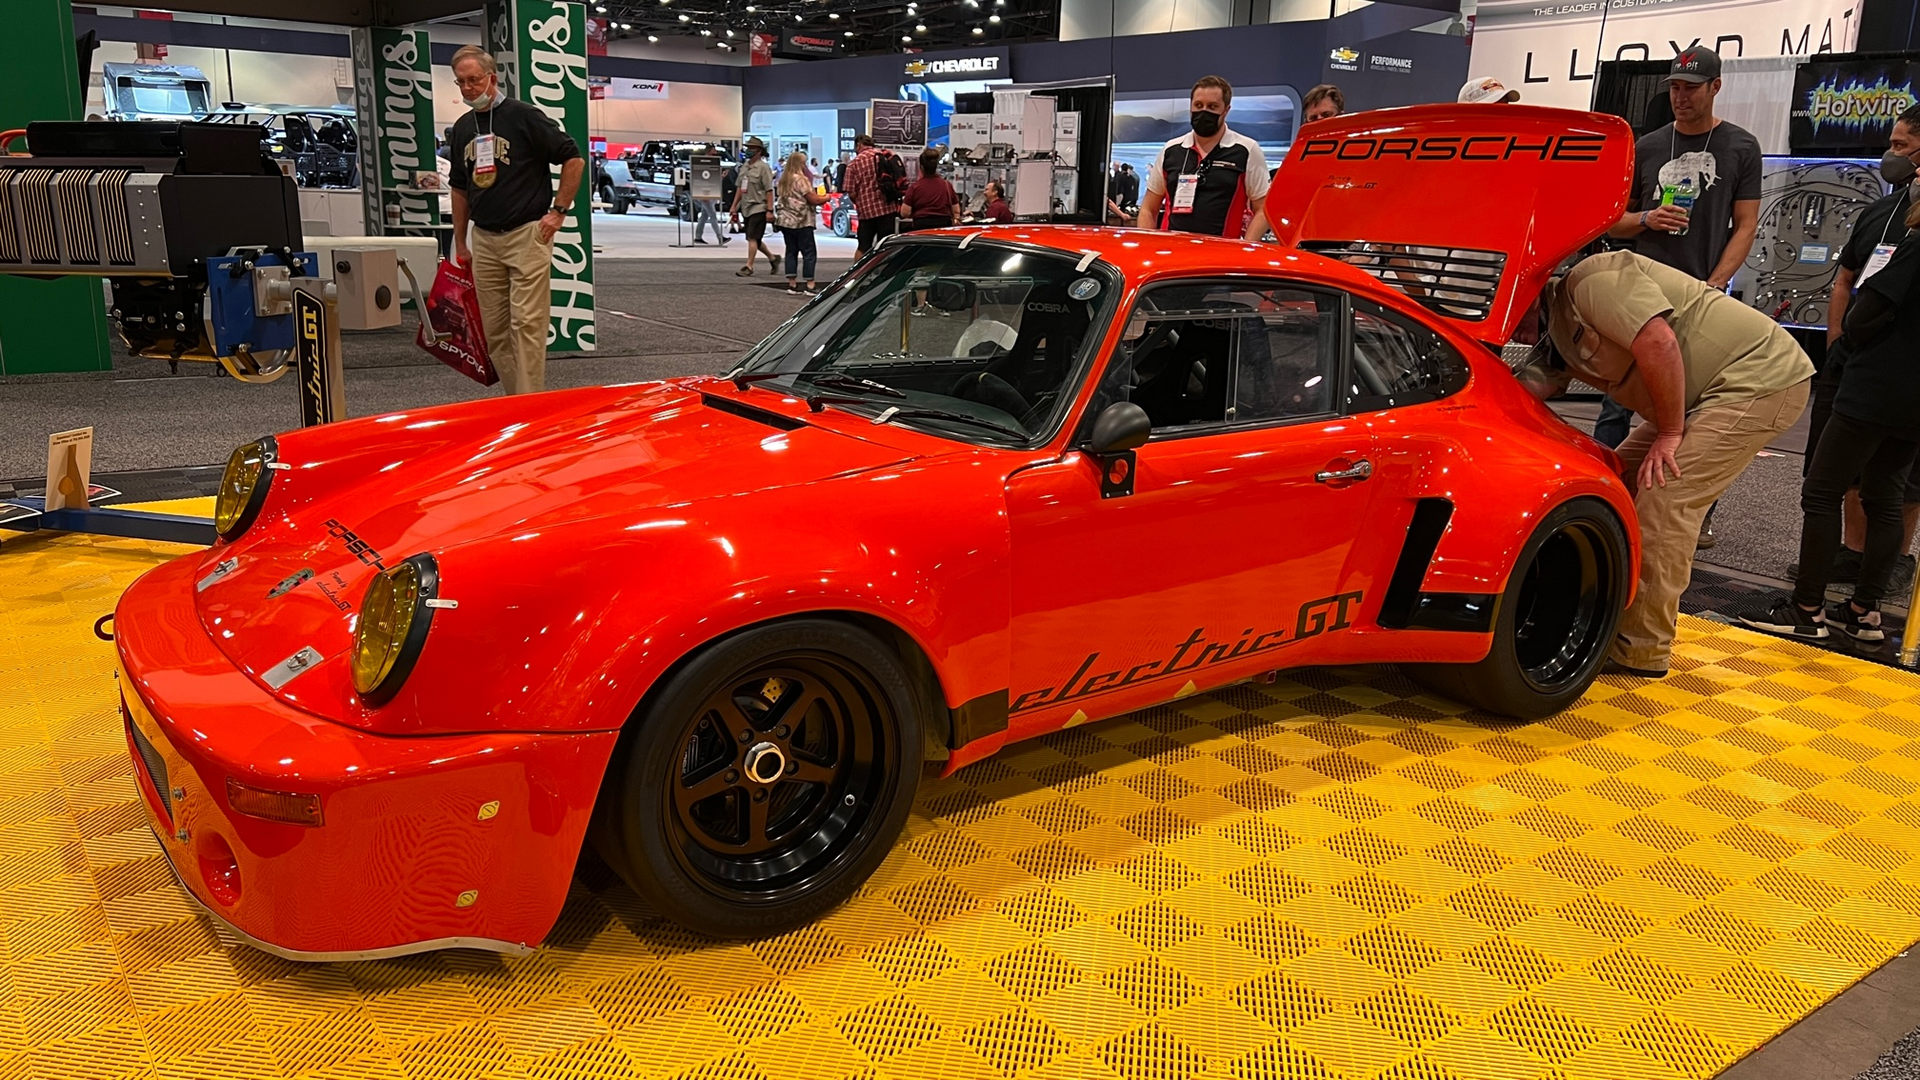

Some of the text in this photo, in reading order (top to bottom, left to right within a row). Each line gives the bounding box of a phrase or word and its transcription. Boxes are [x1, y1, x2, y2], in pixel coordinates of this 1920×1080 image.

[1533, 8, 1553, 16] THE
[1556, 3, 1597, 15] LEADER
[1781, 4, 1857, 56] MAT
[932, 57, 1000, 73] CHEVROLET
[1330, 63, 1358, 71] CHEVROLET
[1371, 55, 1413, 69] PERFORMANCE
[1813, 93, 1908, 118] Hotwire
[377, 30, 433, 237] mmings
[1300, 136, 1606, 162] PORSCHE
[464, 136, 511, 168] PUUE
[529, 2, 594, 350] Hengs
[1027, 302, 1071, 314] COBRA
[303, 305, 324, 425] ctricGT
[439, 341, 487, 376] SPYDR
[320, 518, 387, 571] PORSCH
[1009, 590, 1364, 714] electricGT
